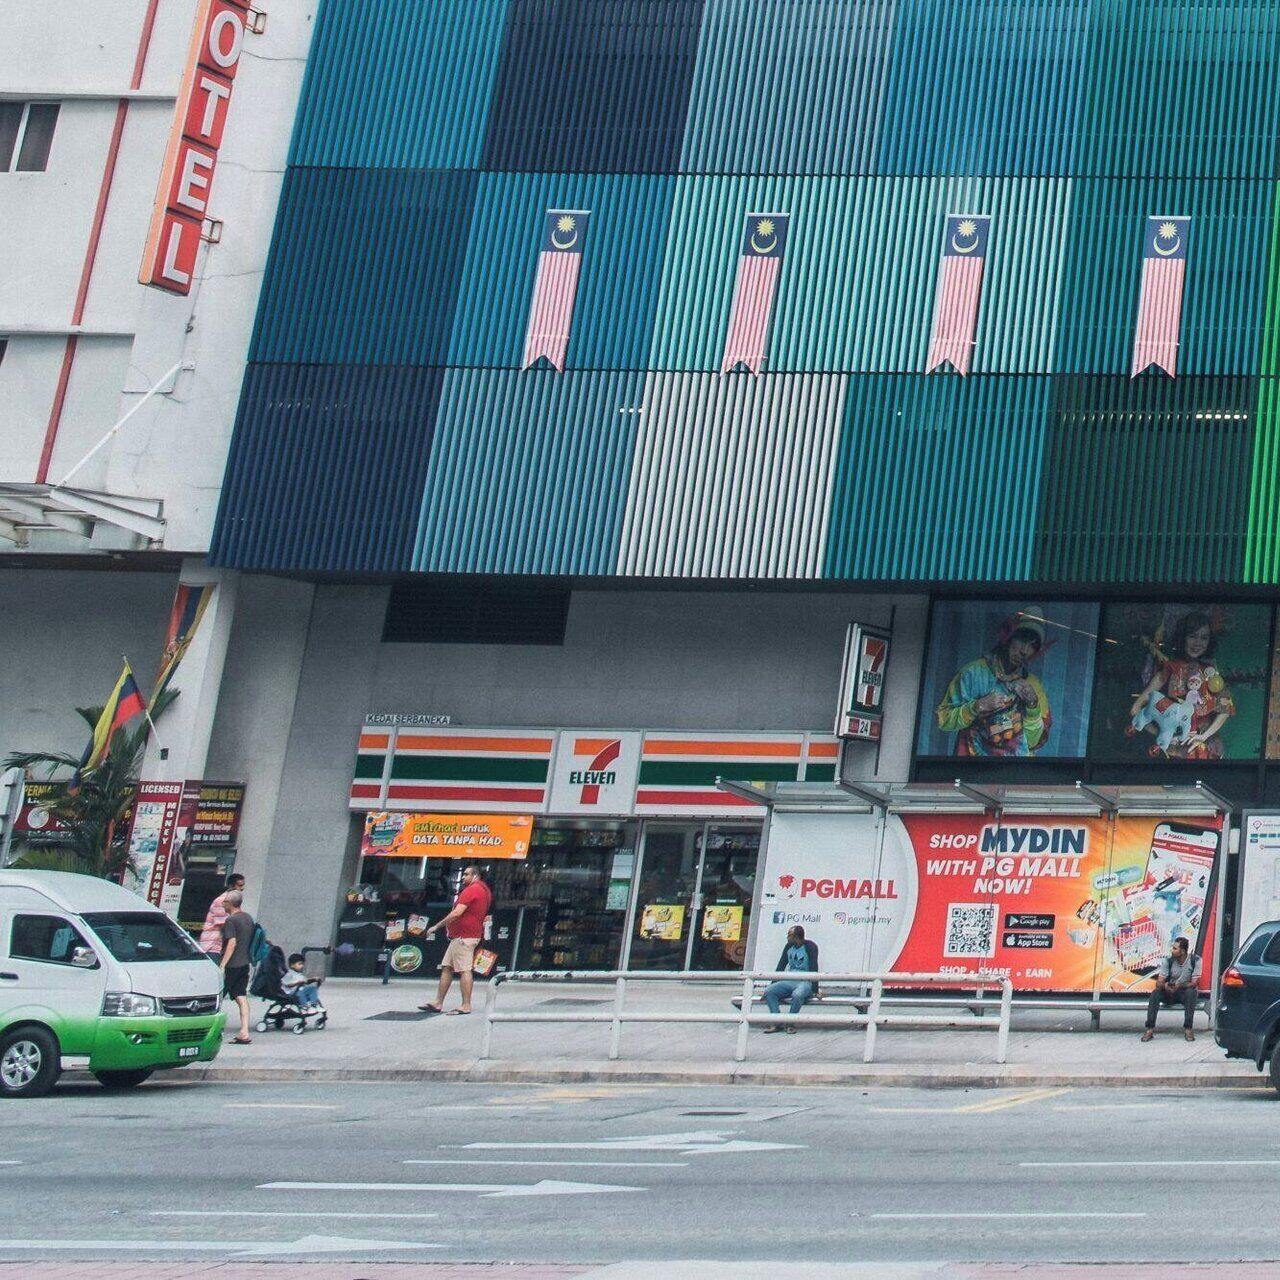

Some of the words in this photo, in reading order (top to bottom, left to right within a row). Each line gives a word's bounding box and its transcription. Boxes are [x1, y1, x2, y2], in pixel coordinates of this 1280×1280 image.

[864, 637, 886, 707] 7
[367, 713, 394, 723] KEDAI
[395, 714, 450, 724] SERBANEKA
[860, 720, 869, 734] 24
[573, 738, 621, 804] 7
[140, 784, 180, 794] LICENSED
[161, 802, 177, 845] MONEY
[461, 823, 490, 833] untuk
[412, 834, 439, 844] DATA
[442, 835, 476, 845] TANPA
[929, 834, 978, 849] SHOP
[981, 828, 1086, 854] MYDIN
[926, 859, 977, 875] WITH
[980, 857, 1014, 876] PG
[1018, 858, 1081, 878] MALL
[800, 879, 897, 899] PGMALL
[973, 878, 1033, 894] NOW!
[786, 914, 800, 923] PG
[803, 913, 821, 923] Mall
[848, 914, 892, 926] pgmall.my
[1017, 939, 1032, 947] App
[1032, 939, 1050, 947] Store
[939, 965, 967, 974] SHOP
[978, 967, 1011, 977] SHARE
[1025, 968, 1053, 978] EARN
